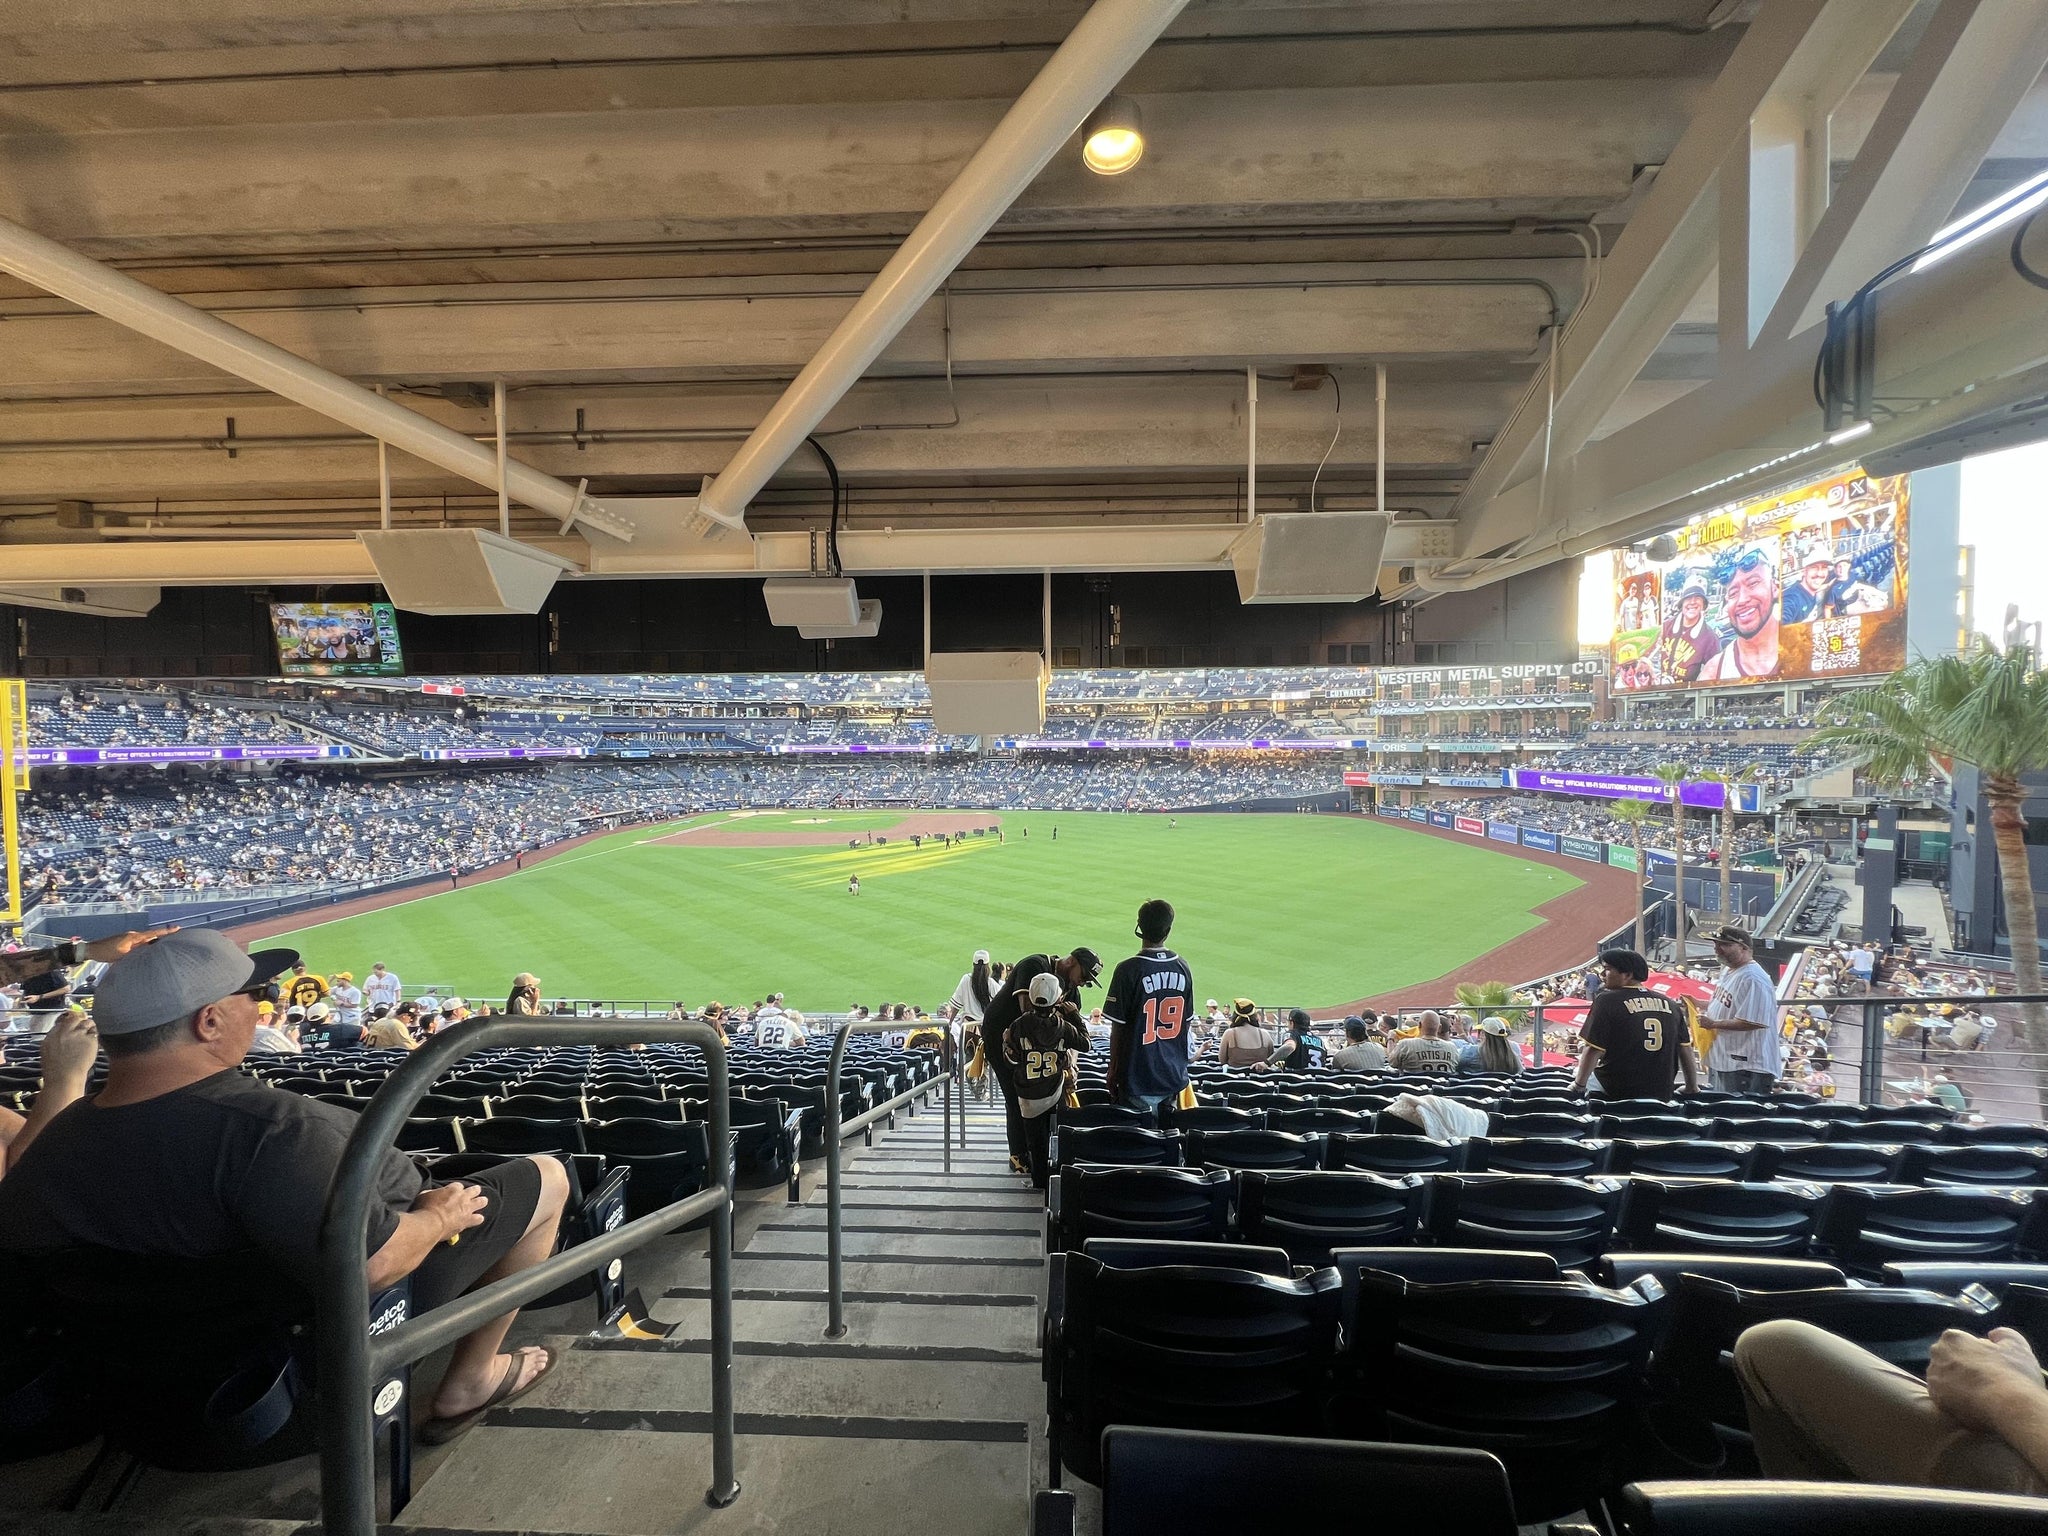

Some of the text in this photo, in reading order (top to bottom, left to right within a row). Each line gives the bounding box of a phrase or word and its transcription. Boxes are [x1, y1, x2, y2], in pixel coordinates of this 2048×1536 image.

[1698, 518, 1735, 546] FAITHFUL
[1378, 660, 1602, 685] WESTERN METAL SUPPLY CO.
[1382, 742, 1407, 752] ORIS
[1524, 833, 1551, 846] Southwest
[1142, 971, 1186, 994] GWYNN
[295, 989, 319, 1008] 19
[1623, 997, 1673, 1014] MERRILL
[1142, 996, 1185, 1045] 19
[763, 1026, 785, 1045] 22
[1643, 1017, 1663, 1052] 3
[1026, 1051, 1058, 1080] 23
[1307, 1048, 1323, 1070] 3
[1416, 1050, 1441, 1061] TATIS
[605, 1204, 623, 1231] petco
[375, 1310, 406, 1336] ark
[381, 1386, 396, 1409] 23
